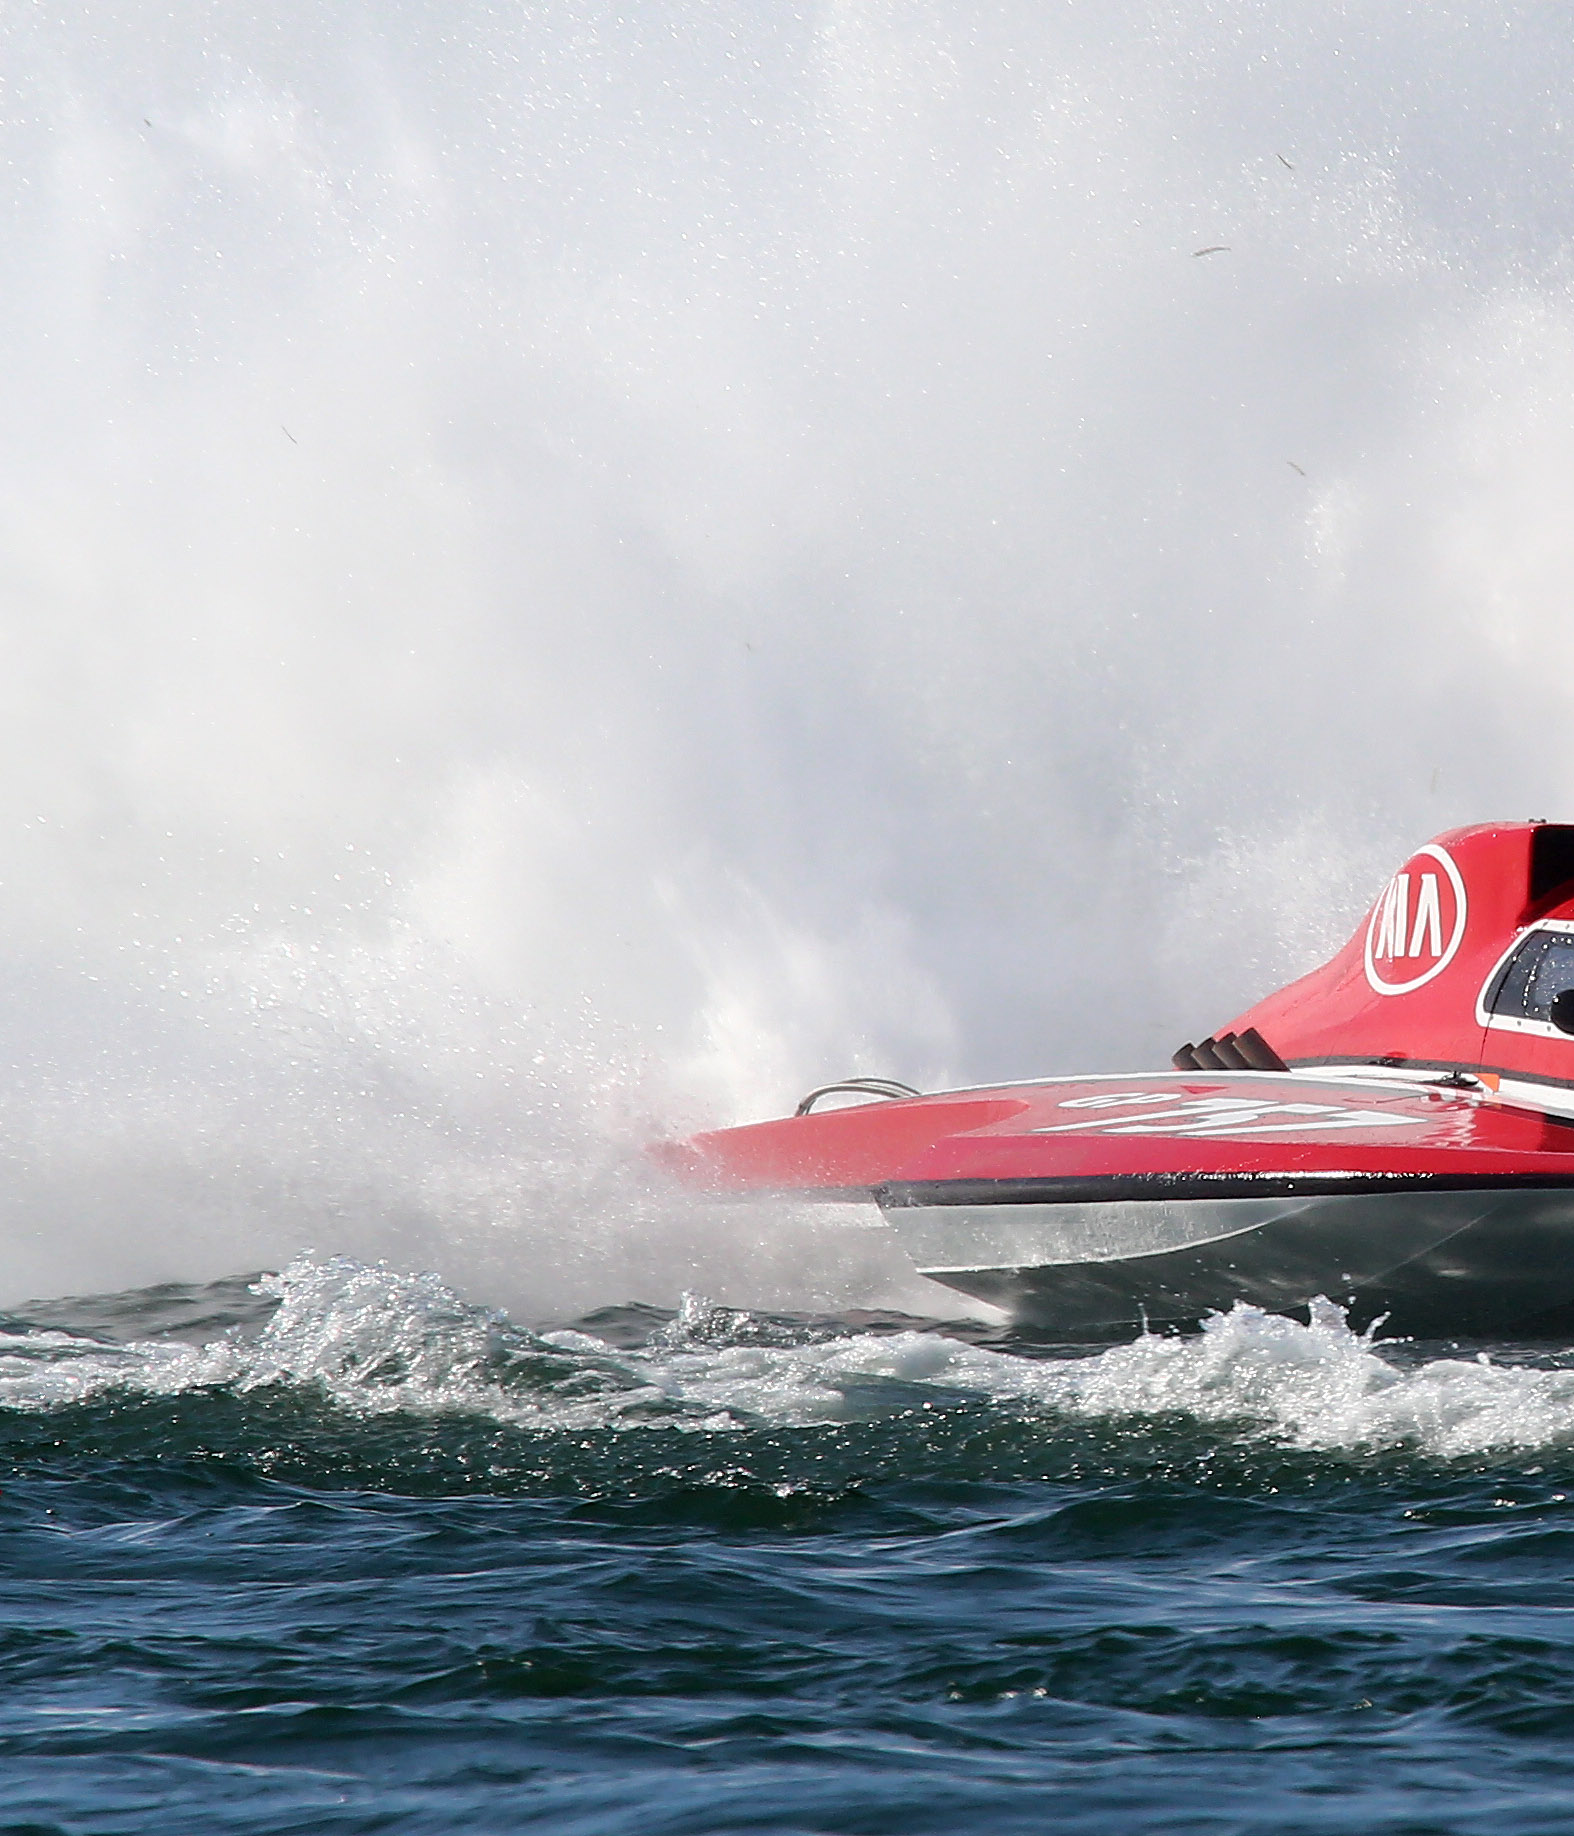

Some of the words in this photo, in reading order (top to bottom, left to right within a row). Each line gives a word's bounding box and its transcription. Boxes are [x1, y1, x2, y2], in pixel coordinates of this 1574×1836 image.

[1375, 873, 1442, 958] KIA
[1030, 1097, 1429, 1137] 757
[1057, 1092, 1183, 1109] GP
